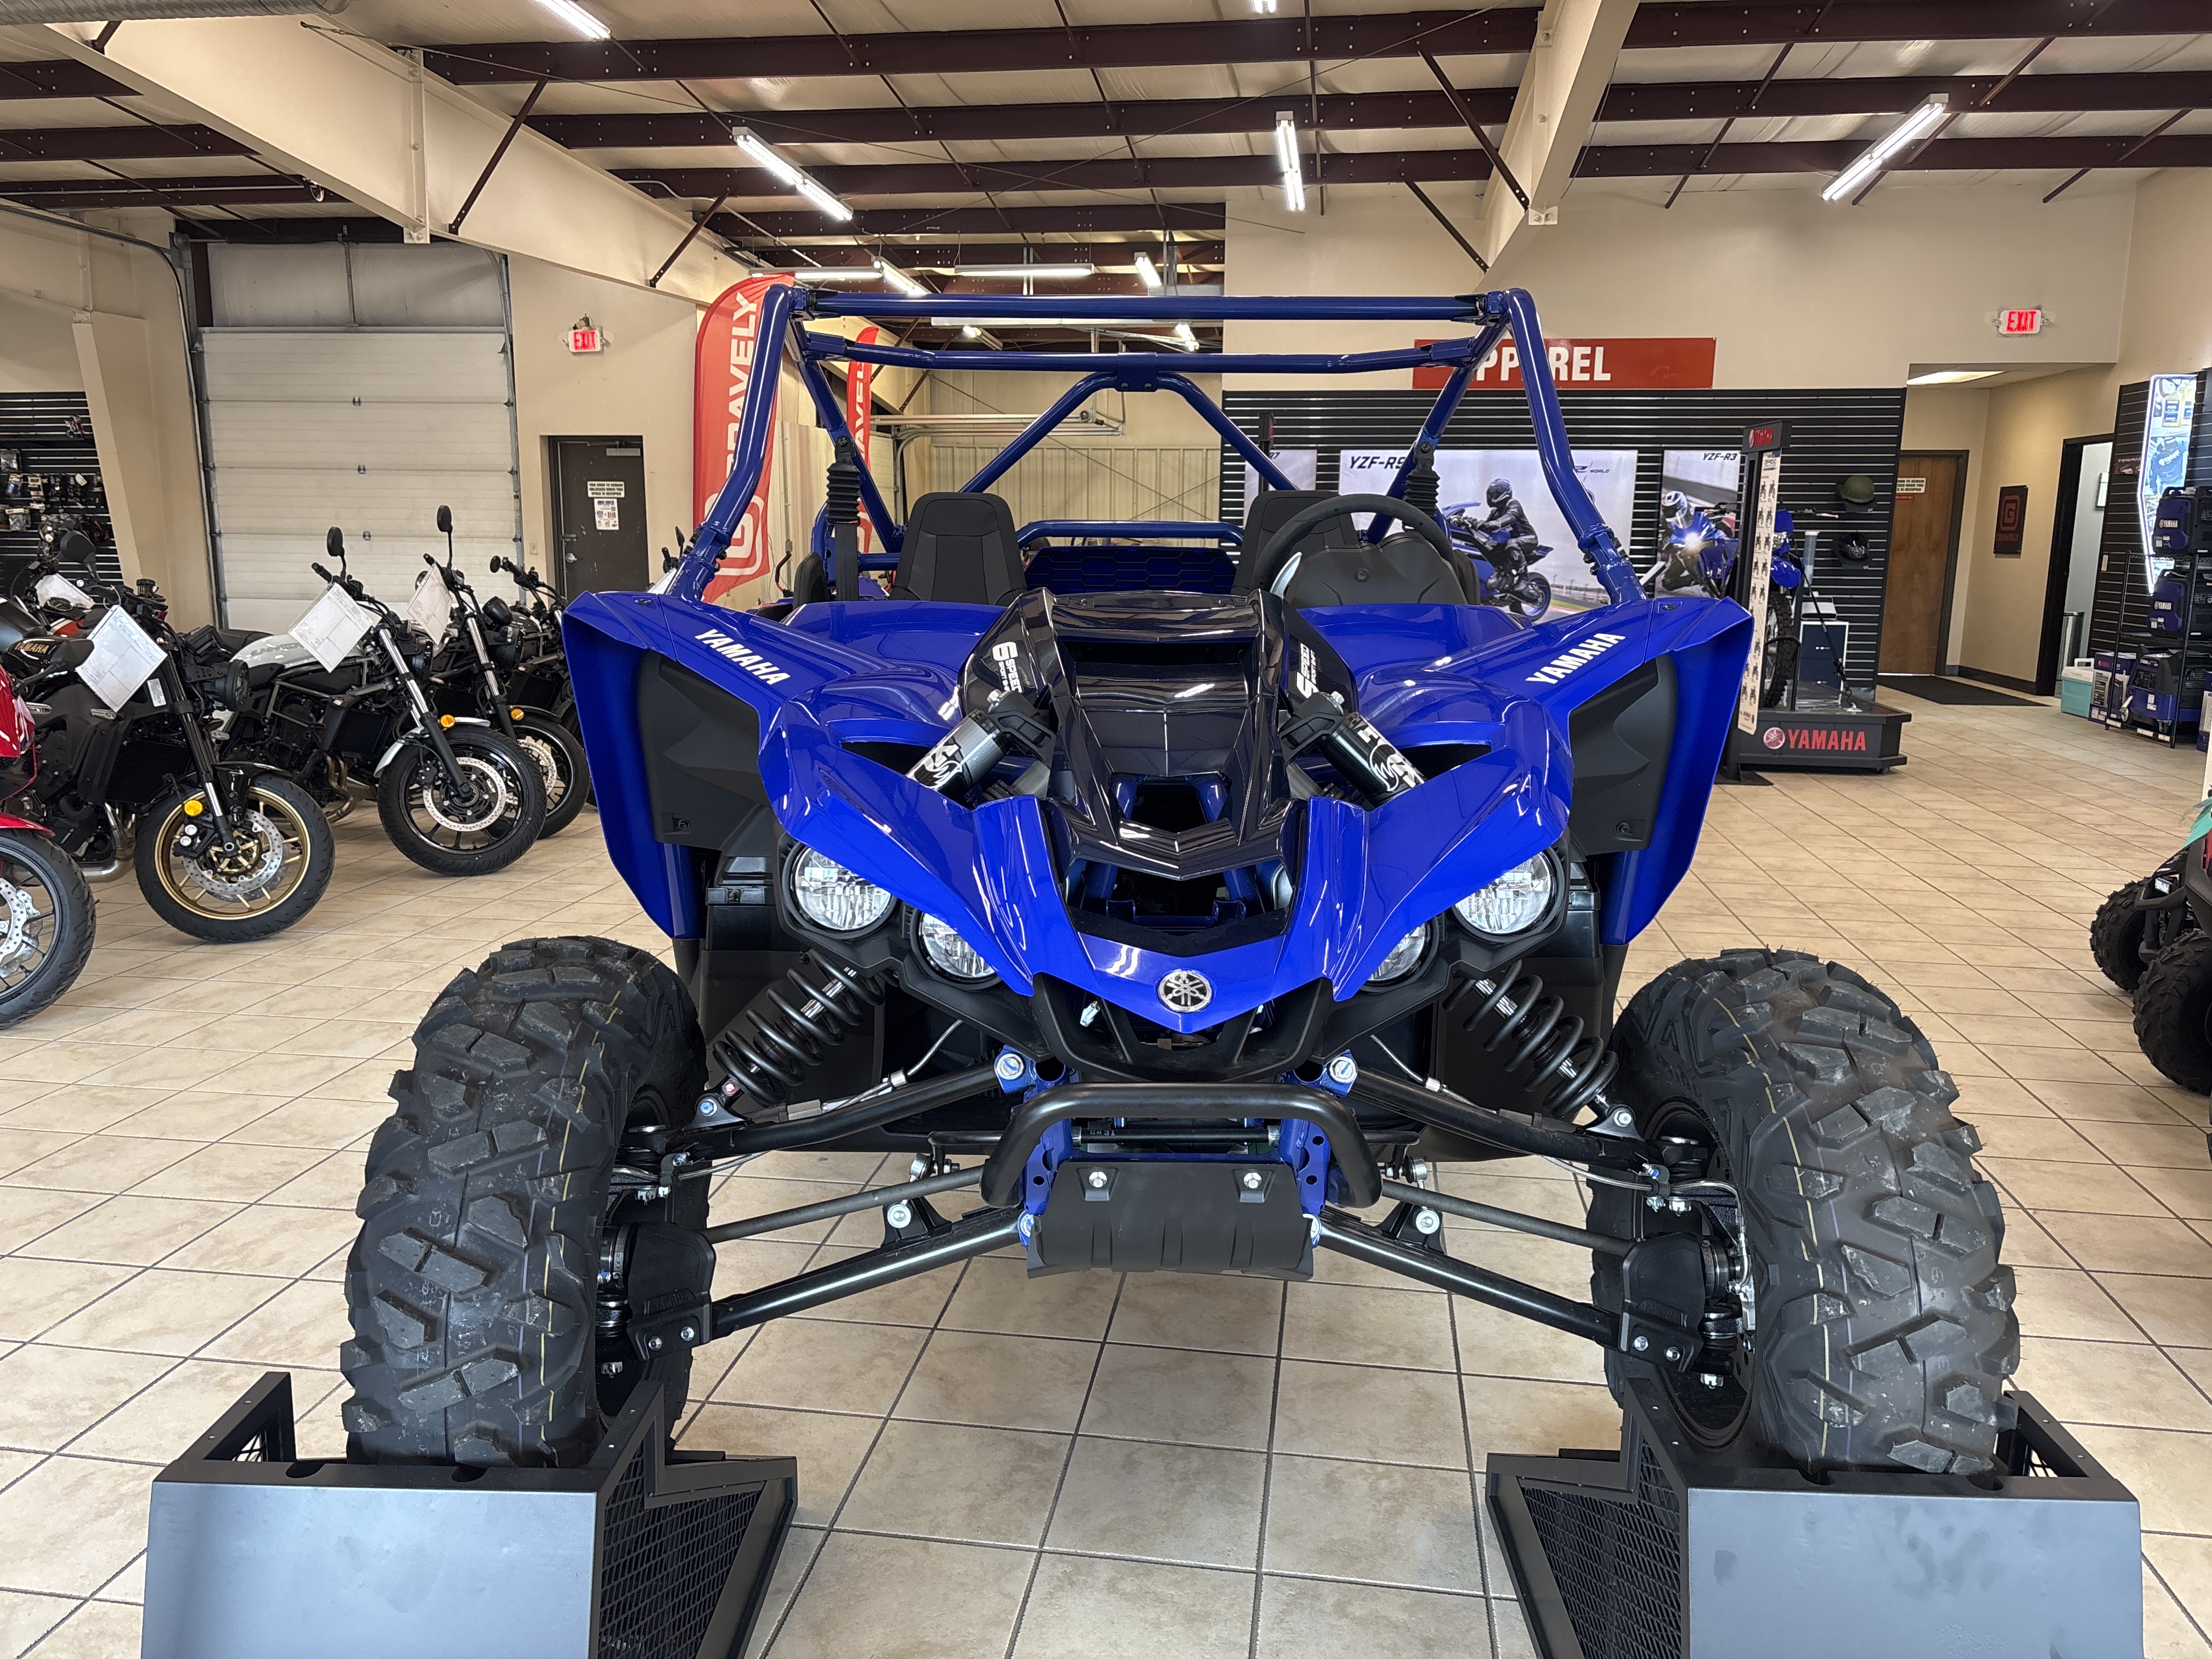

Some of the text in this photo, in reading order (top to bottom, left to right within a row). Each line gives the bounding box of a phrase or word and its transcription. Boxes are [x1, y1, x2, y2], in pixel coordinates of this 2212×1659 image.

[2007, 311, 2036, 332] EXIT
[573, 331, 595, 350] EXIT
[1472, 347, 1611, 381] PPREL
[1703, 453, 1737, 461] YZF-R3
[14, 642, 49, 654] YAMAHA
[695, 629, 791, 685] YAMAHA
[992, 642, 1018, 661] 6
[1525, 633, 1626, 684] YAMAHA
[998, 661, 1007, 679] SPORT
[1300, 642, 1310, 680] SPEED
[1787, 729, 1866, 752] YAMAHA
